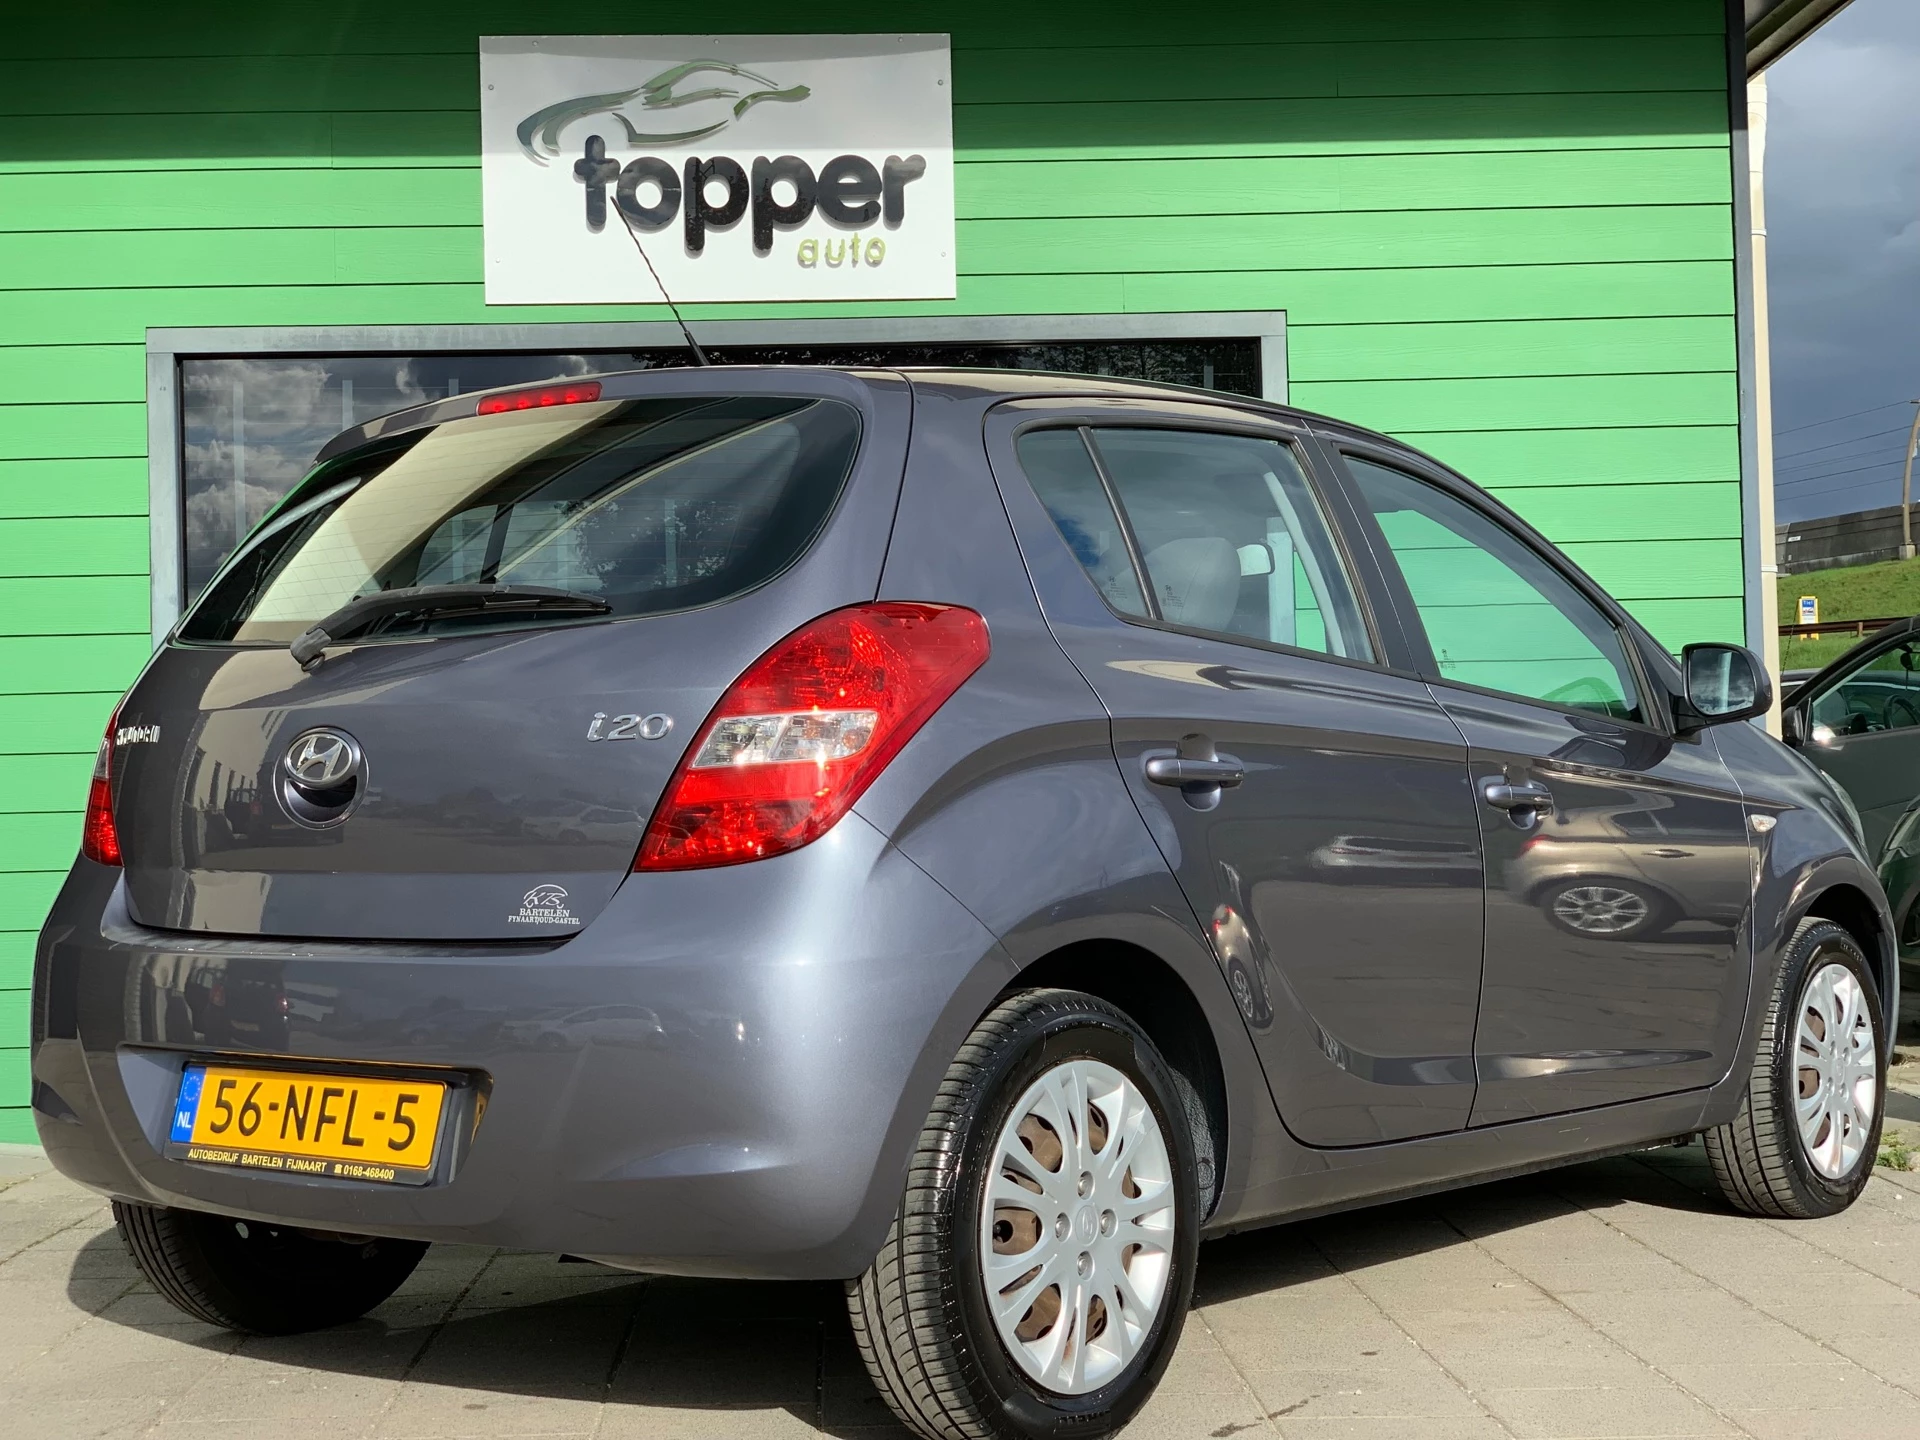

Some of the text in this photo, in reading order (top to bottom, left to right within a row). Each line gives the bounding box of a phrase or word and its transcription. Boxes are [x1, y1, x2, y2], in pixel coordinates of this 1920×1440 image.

[573, 134, 928, 257] topper
[797, 233, 886, 267] auto
[586, 711, 674, 742] i20
[519, 907, 571, 918] BARTELEN
[176, 1110, 193, 1129] NL
[209, 1079, 420, 1152] 56-NFL-5
[188, 1148, 240, 1163] AUTOBEDRIJF
[241, 1153, 283, 1169] BARTELEN
[286, 1158, 328, 1173] FIJNAART
